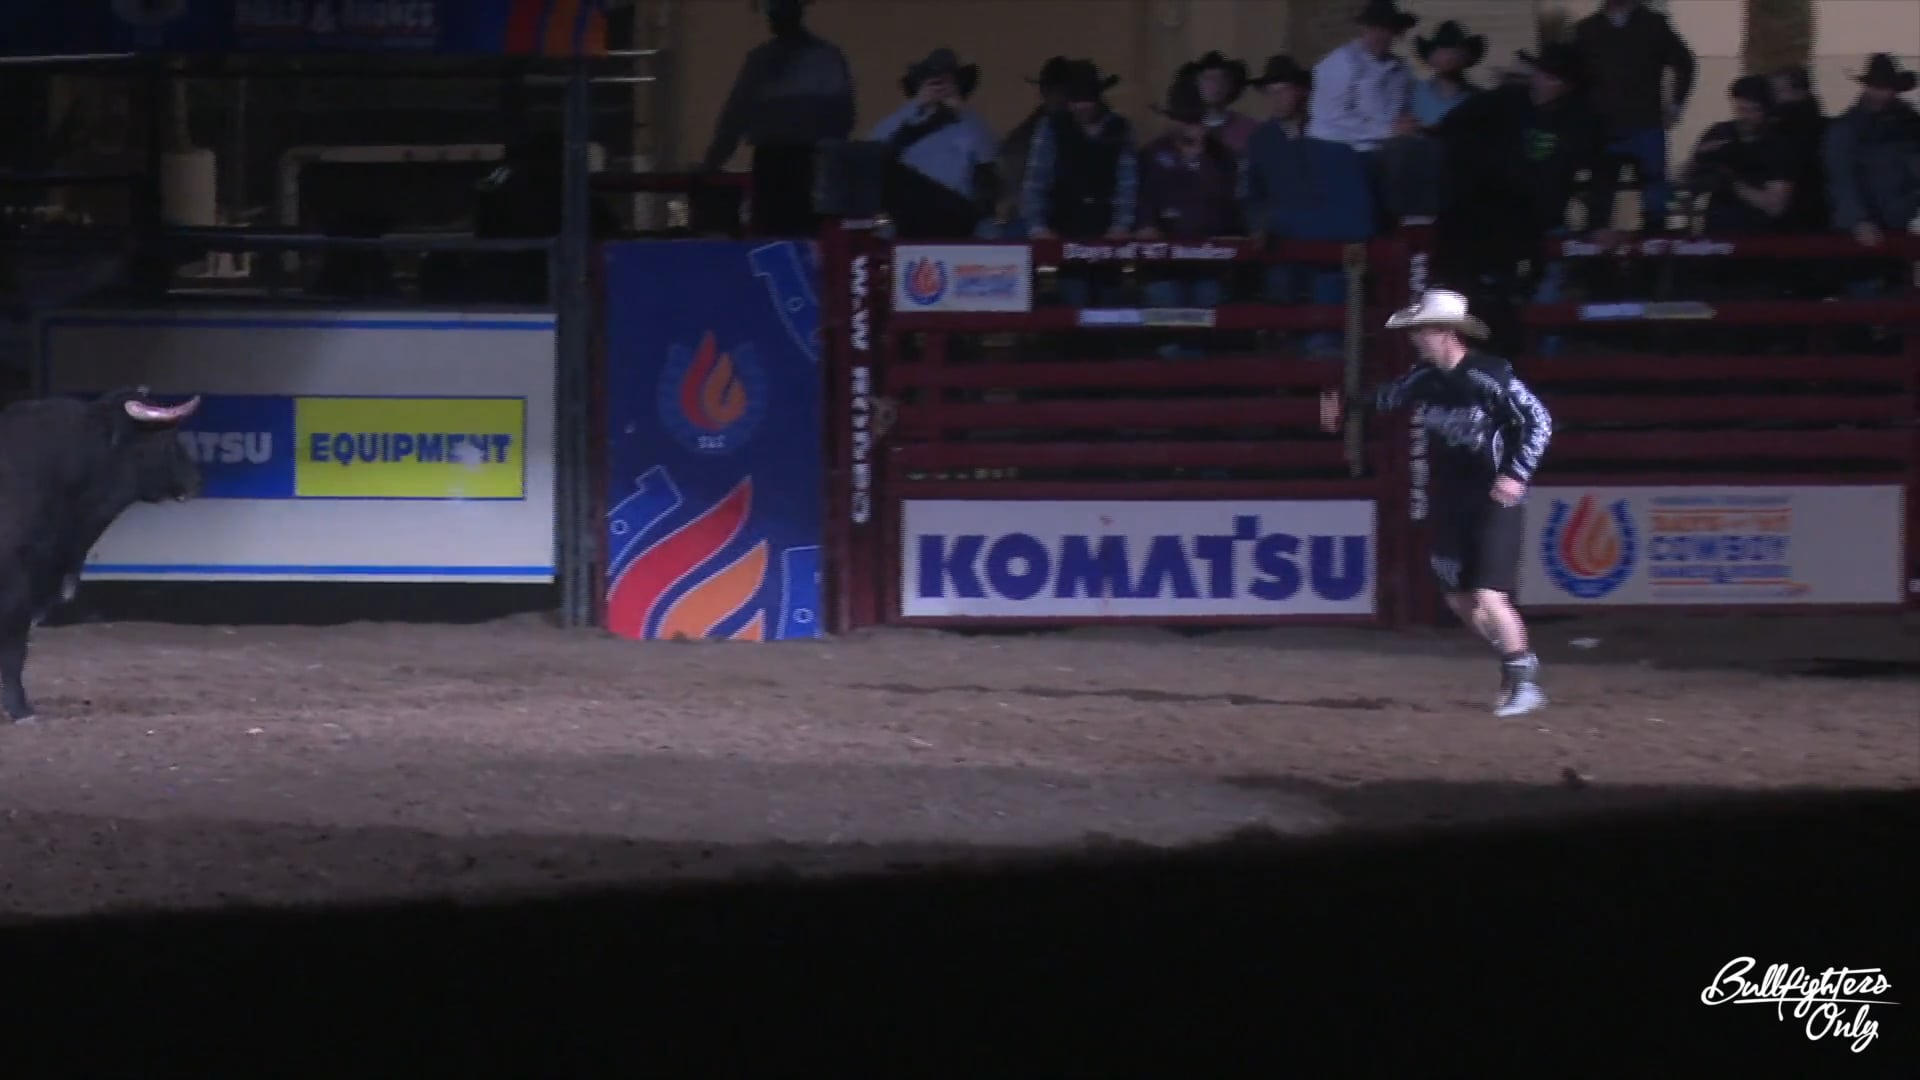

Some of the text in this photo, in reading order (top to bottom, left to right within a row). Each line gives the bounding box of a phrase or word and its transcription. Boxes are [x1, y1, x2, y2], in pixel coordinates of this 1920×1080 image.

[177, 432, 512, 465] ATSU EQUIPMENT
[919, 515, 1367, 600] KOMATSU
